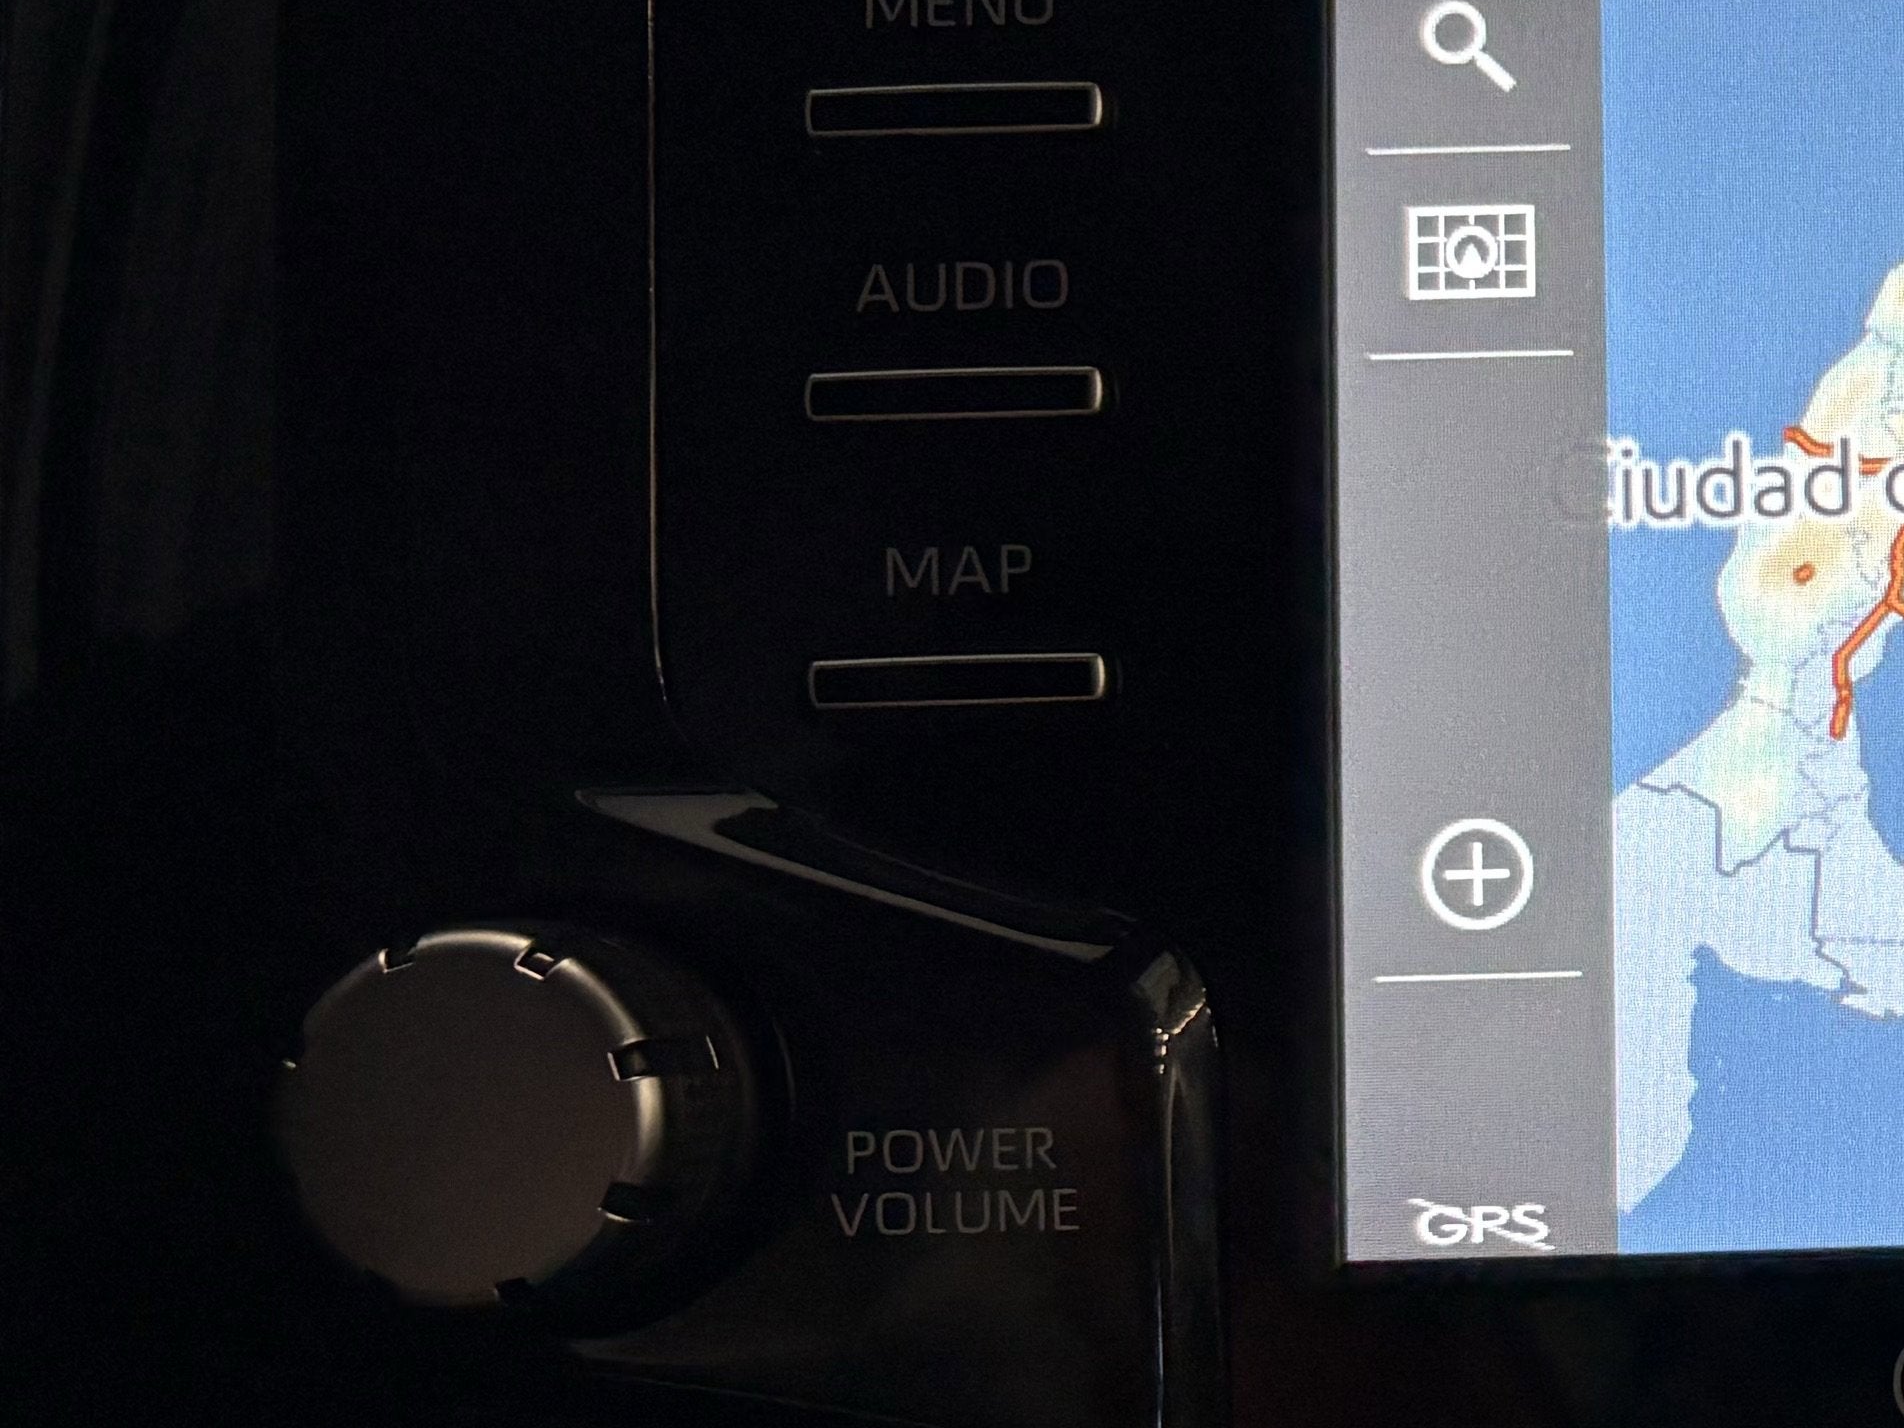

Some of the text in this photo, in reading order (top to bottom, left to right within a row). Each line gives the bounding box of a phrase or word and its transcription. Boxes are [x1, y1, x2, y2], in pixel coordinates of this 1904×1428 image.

[855, 259, 1071, 314] AUDIO
[1606, 436, 1852, 521] iudad
[884, 545, 1034, 597] MAP
[845, 1125, 1058, 1175] POWER
[830, 1186, 1081, 1238] VOLUME
